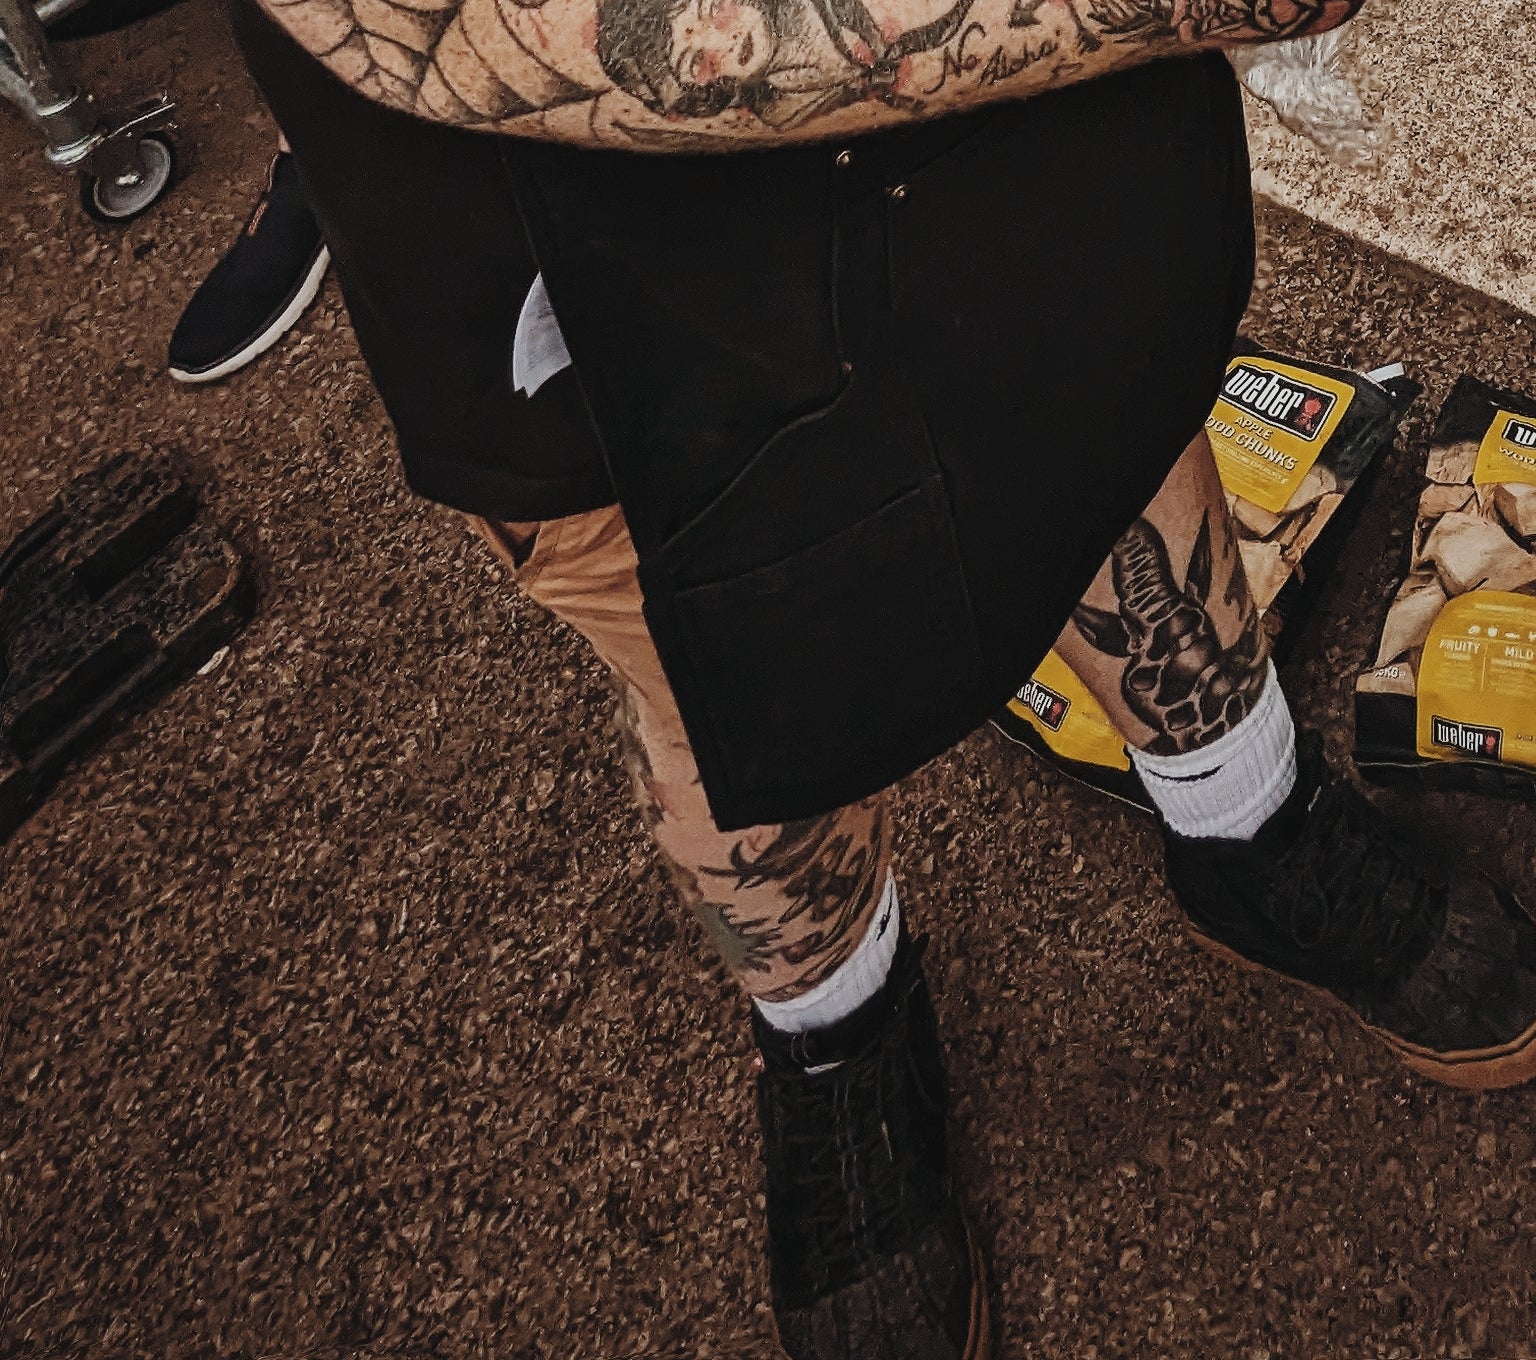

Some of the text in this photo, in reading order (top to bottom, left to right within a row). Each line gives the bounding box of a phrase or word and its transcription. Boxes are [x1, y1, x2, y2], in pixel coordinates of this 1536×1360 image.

[1224, 368, 1305, 420] weber
[1205, 416, 1236, 438] OOD
[1235, 434, 1299, 470] CHUNKS
[1235, 416, 1274, 440] APPLE
[1504, 646, 1535, 660] MILD
[1437, 723, 1484, 753] weber
